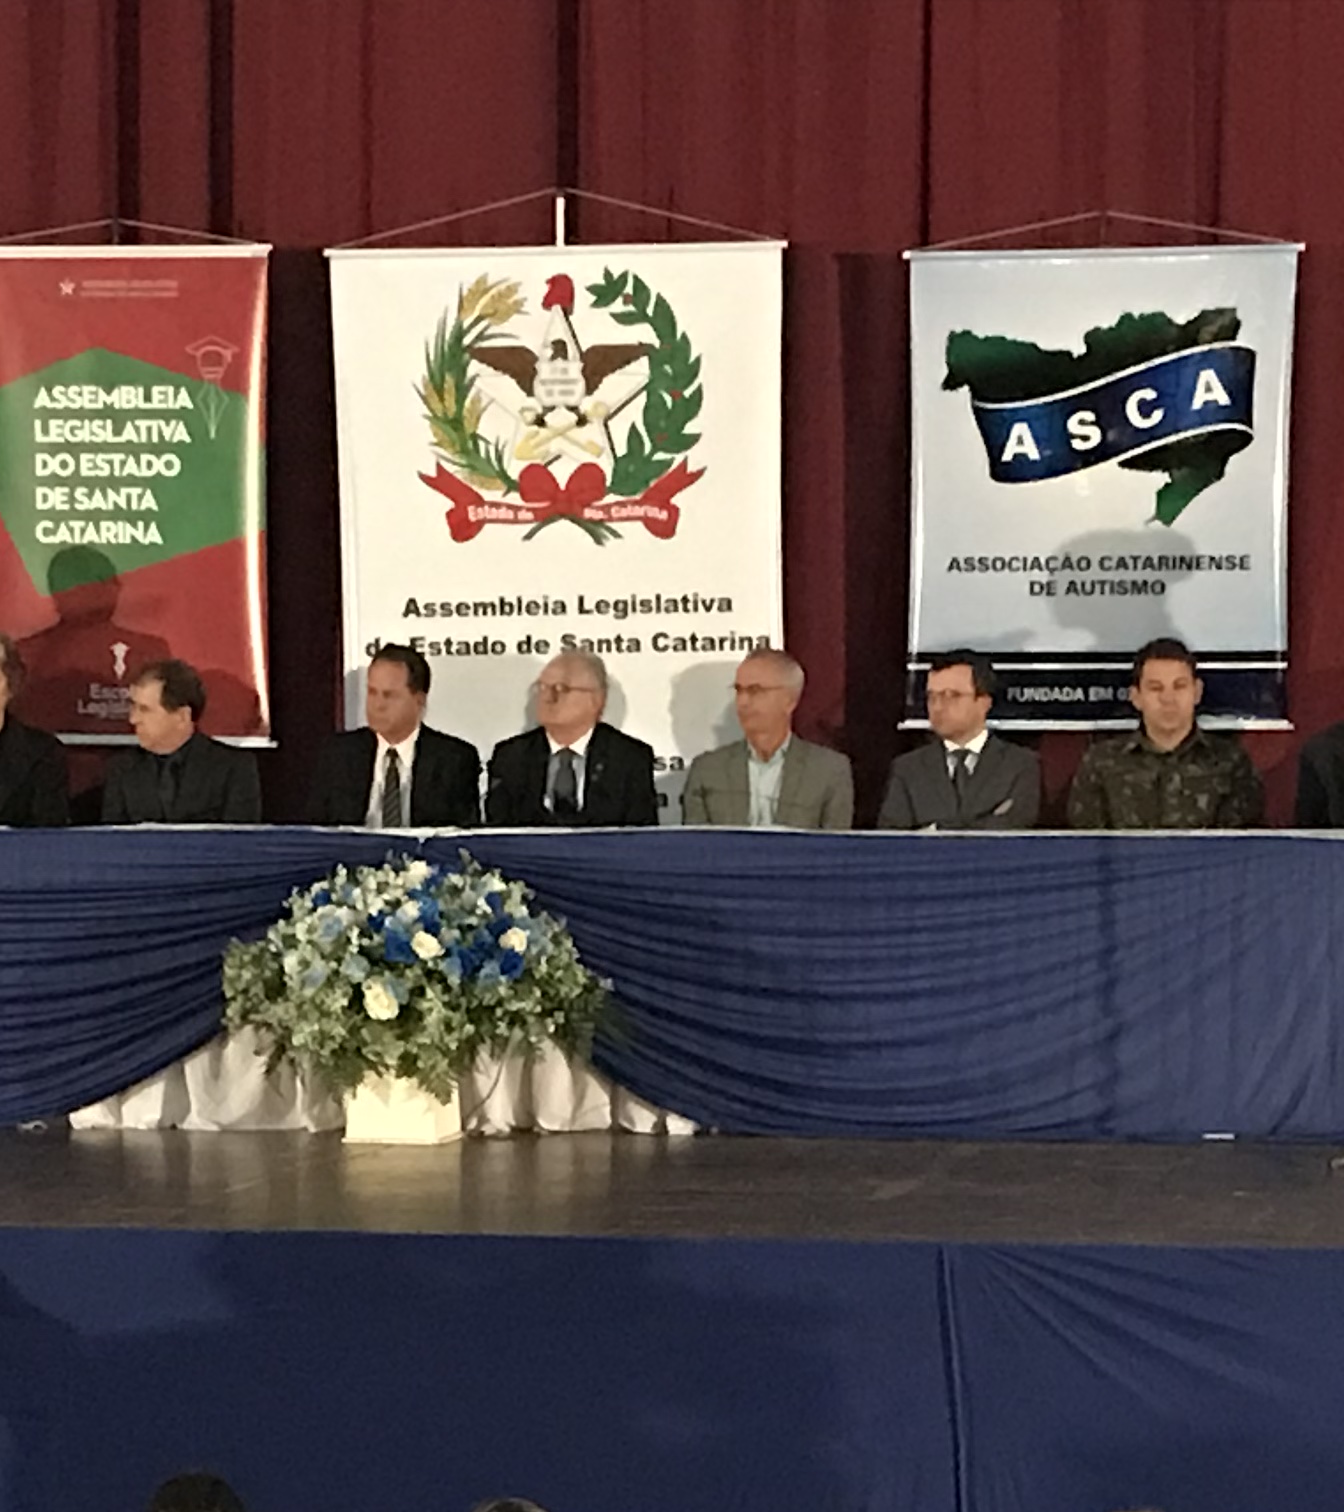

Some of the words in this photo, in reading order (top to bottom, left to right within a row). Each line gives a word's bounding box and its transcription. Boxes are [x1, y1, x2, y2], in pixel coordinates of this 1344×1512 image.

[33, 385, 194, 409] ASSEMBLEIA
[1001, 368, 1231, 462] ASCA
[33, 418, 192, 443] LEGISLATIVA
[34, 453, 76, 477] DO
[79, 453, 181, 477] ESTADO
[35, 487, 70, 511] DE
[74, 487, 159, 511] SANTA
[35, 519, 164, 544] CATARINA
[947, 553, 1093, 576] ASSOCIAÇÃO
[1098, 554, 1251, 573] CATARINENSE
[1029, 579, 1057, 596] DE
[1064, 579, 1167, 597] AUTISMO
[402, 596, 567, 618] Assembleia
[577, 593, 734, 619] Legislativa
[409, 635, 507, 656] Estado
[516, 635, 551, 654] de
[560, 633, 642, 654] Santa
[651, 632, 771, 653] Catarina
[1007, 686, 1085, 702] FUNDADA
